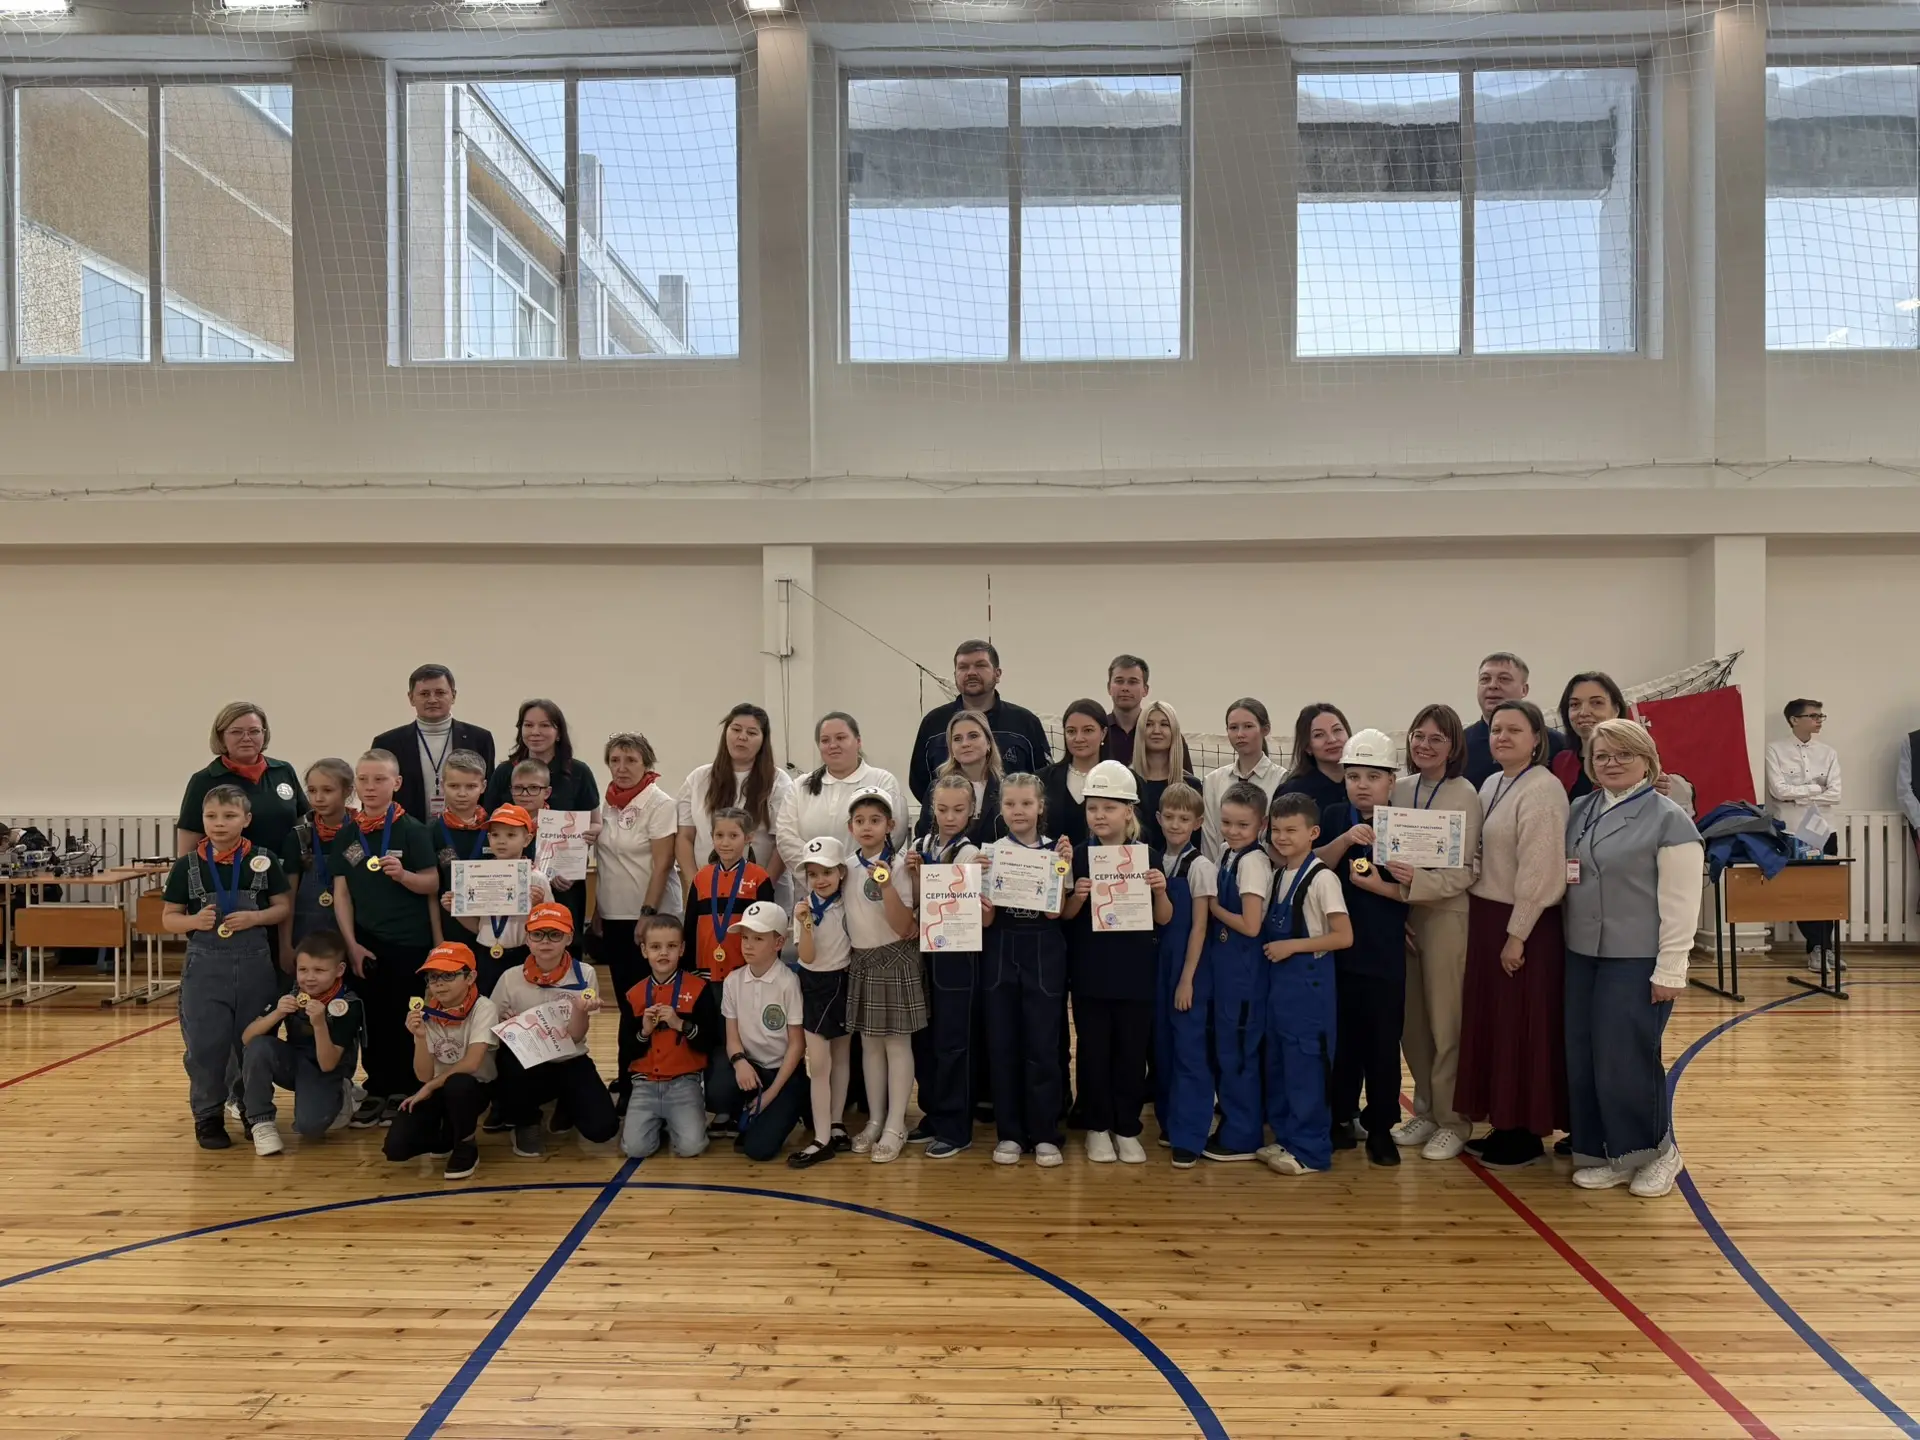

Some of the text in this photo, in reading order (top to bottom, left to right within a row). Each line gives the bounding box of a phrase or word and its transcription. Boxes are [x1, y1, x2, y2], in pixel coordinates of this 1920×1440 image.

[1094, 872, 1146, 880] СЕРТИФИКАТ
[925, 891, 977, 899] СЕРТИФИКАТ
[535, 1009, 562, 1052] СЕРТИФИКАТ
